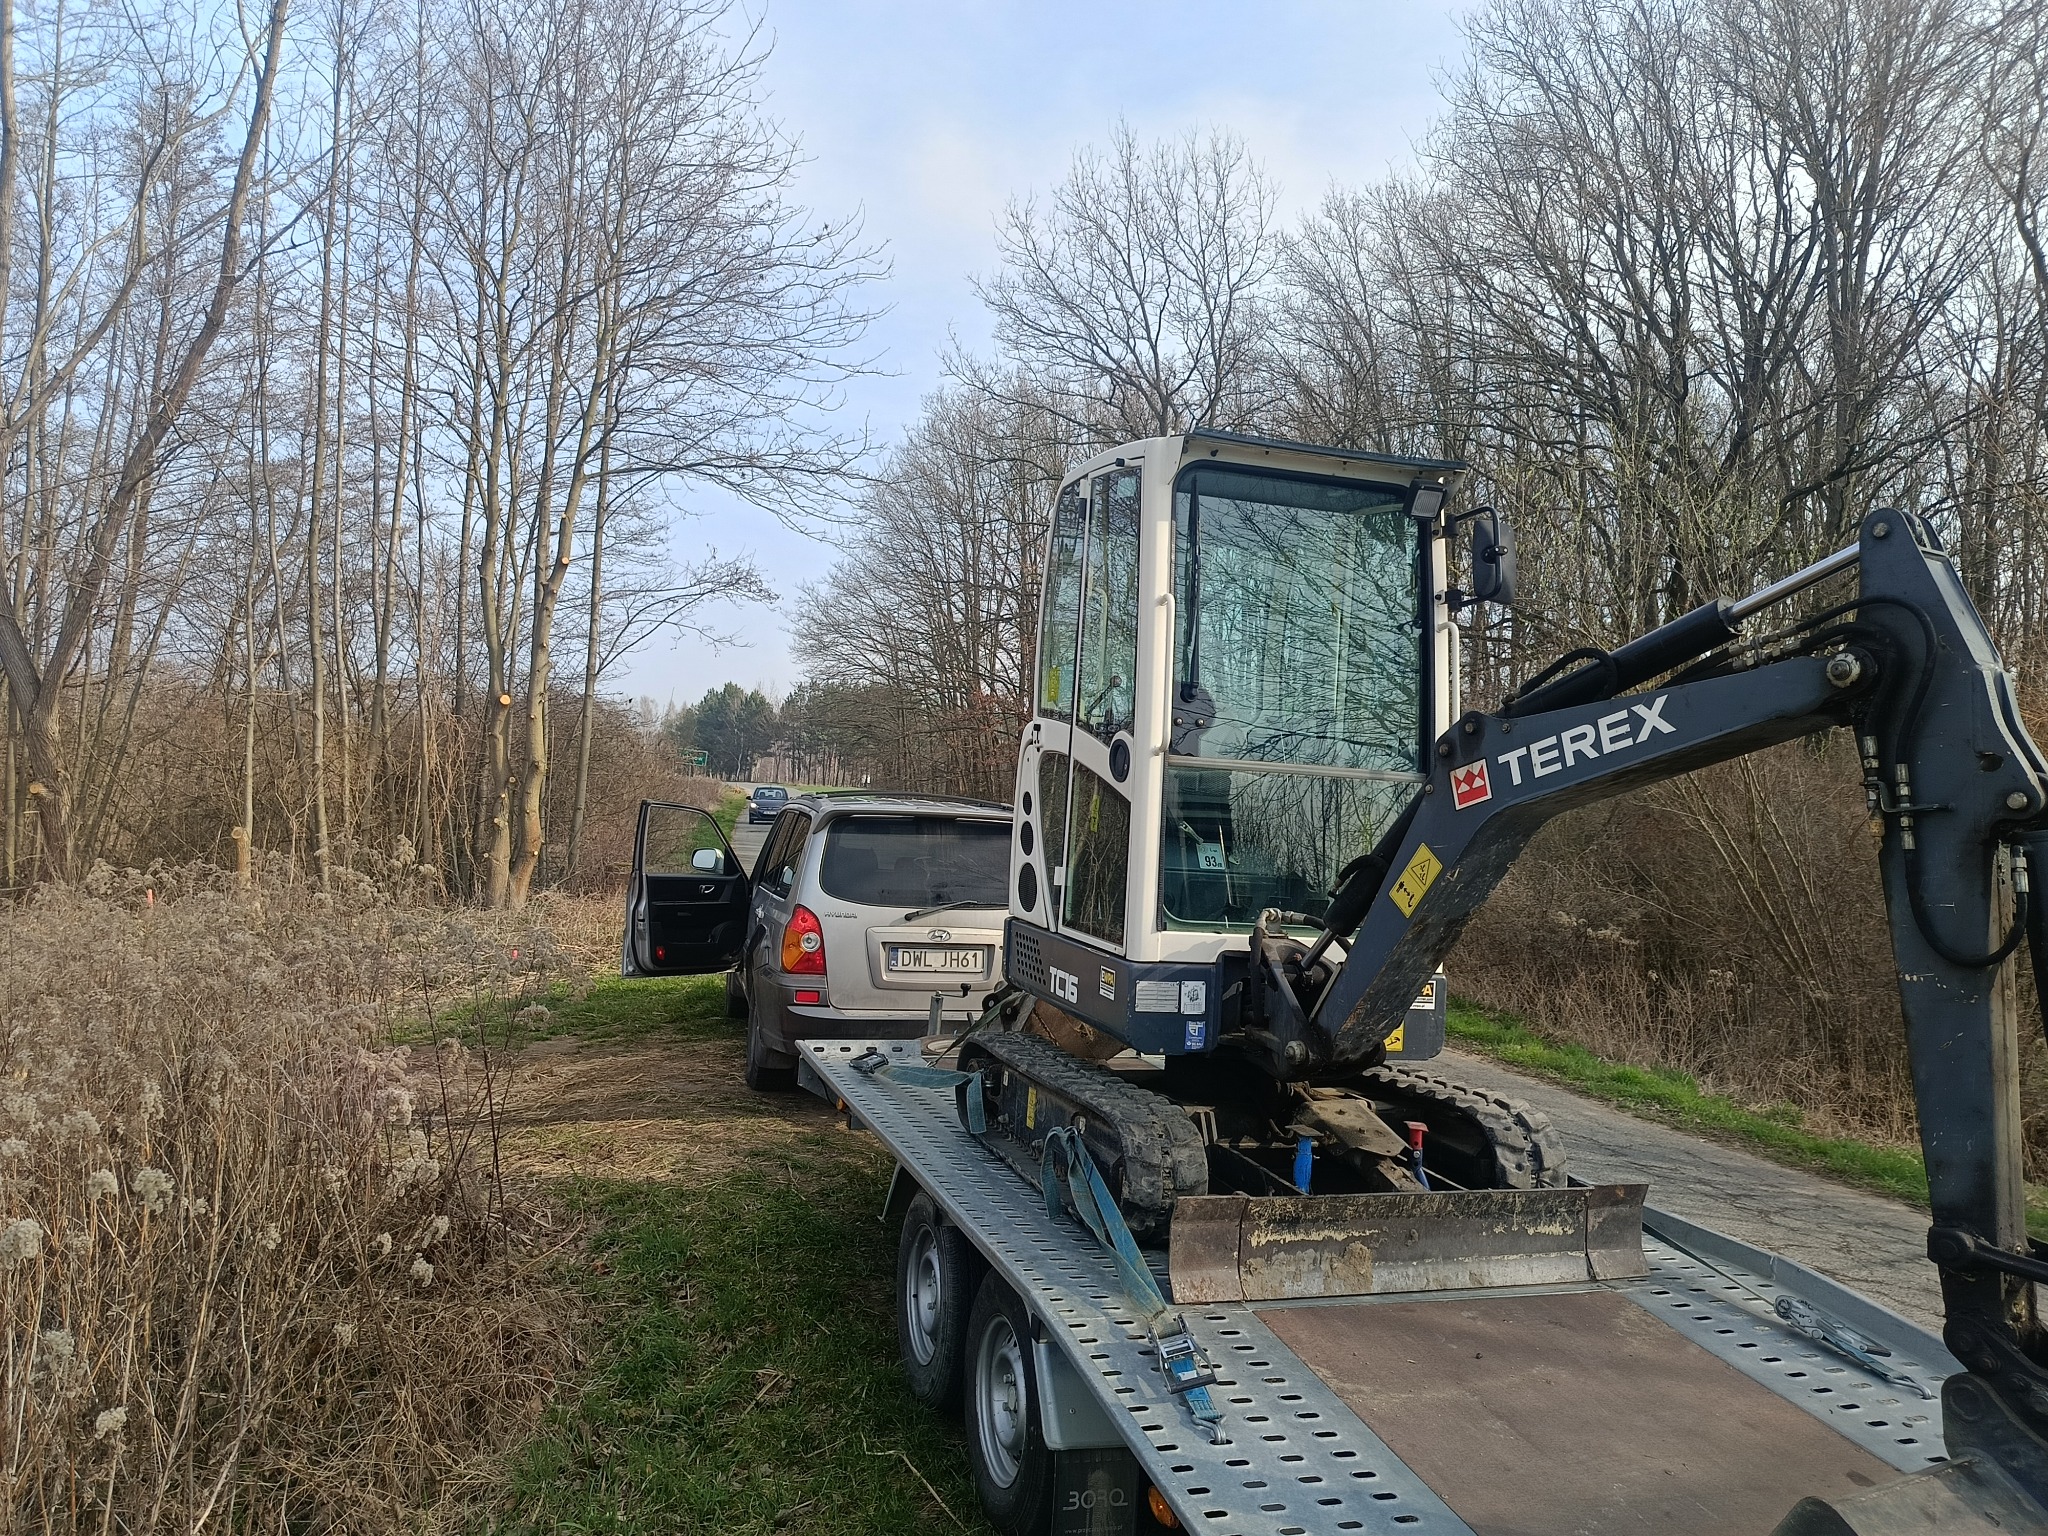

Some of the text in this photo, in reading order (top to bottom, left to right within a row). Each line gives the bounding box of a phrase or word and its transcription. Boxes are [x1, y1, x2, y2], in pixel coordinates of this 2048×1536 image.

[1498, 694, 1677, 786] TEREX
[901, 950, 978, 968] DWL JH61
[1049, 965, 1079, 1004] TC16
